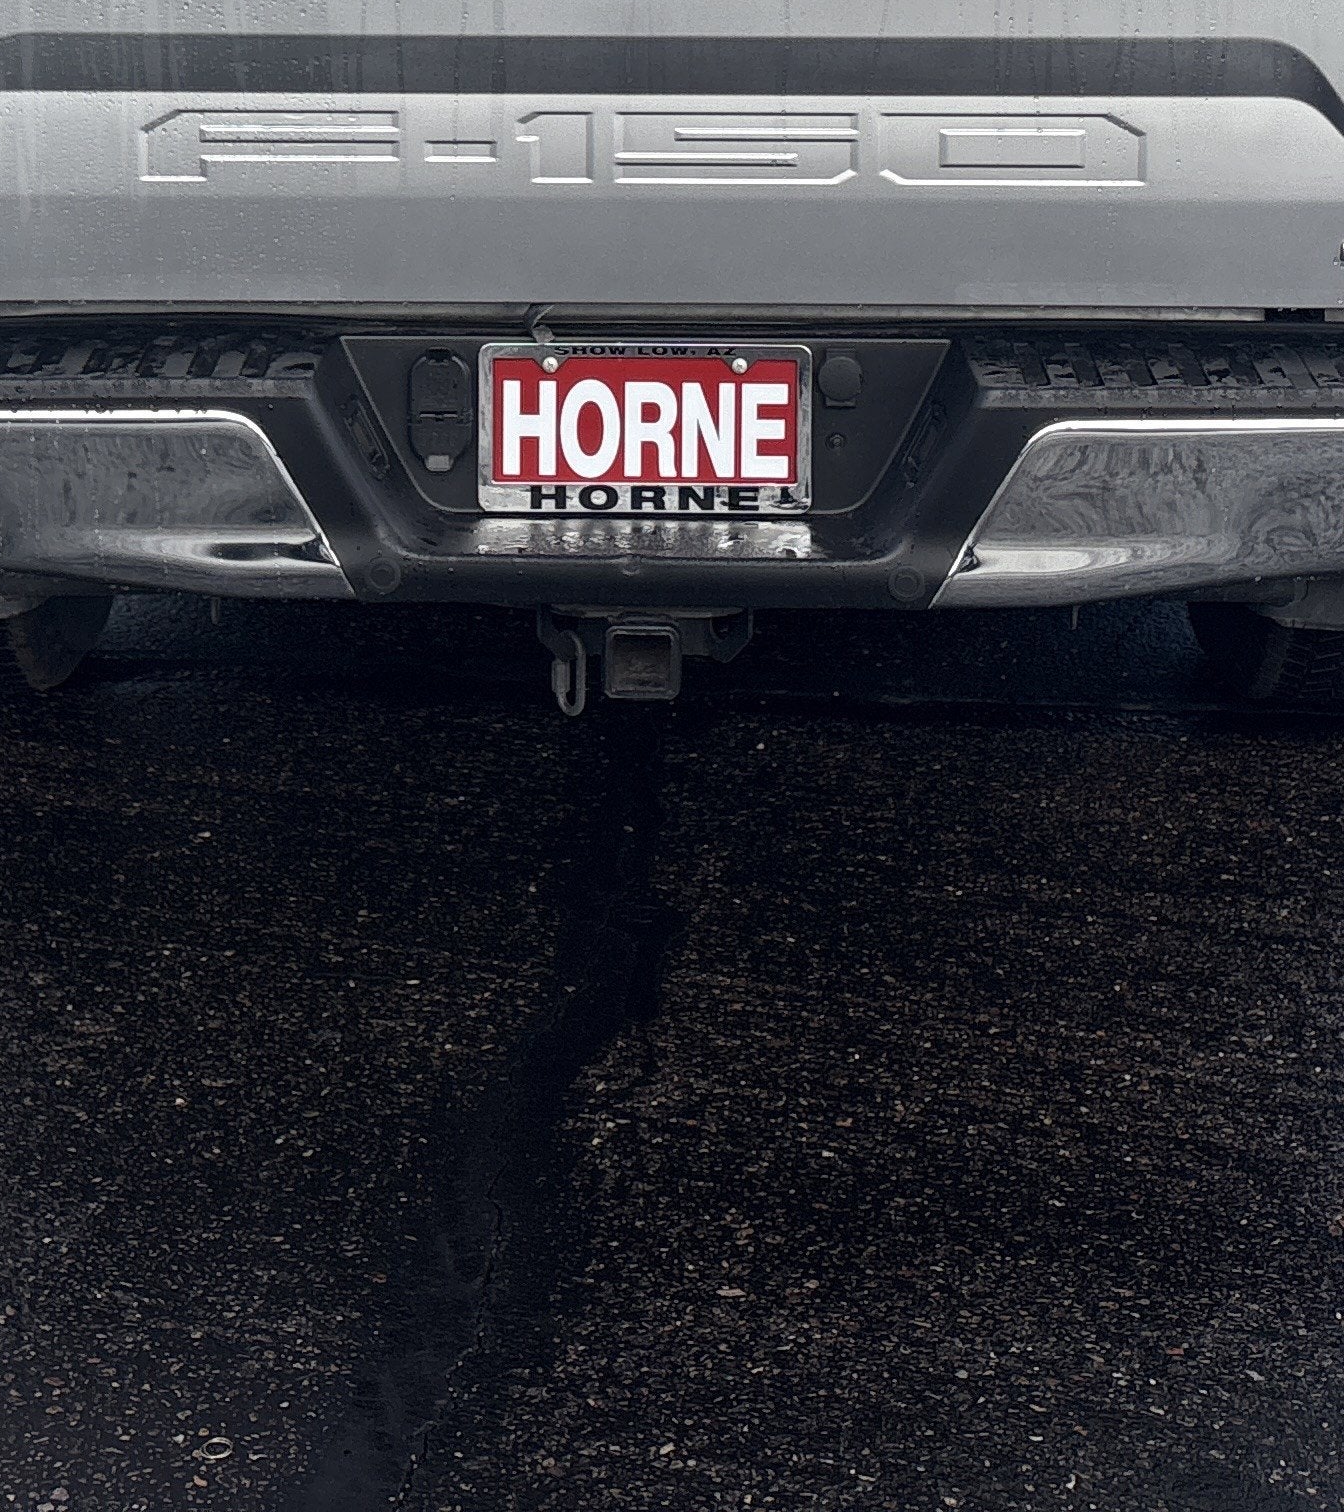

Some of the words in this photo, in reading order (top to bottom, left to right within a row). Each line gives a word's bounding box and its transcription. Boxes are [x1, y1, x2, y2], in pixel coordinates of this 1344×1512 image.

[138, 108, 1149, 187] F-150
[554, 346, 627, 356] SHOW
[707, 347, 737, 356] AZ
[501, 378, 790, 479] HORNE
[530, 485, 761, 511] HORNE
